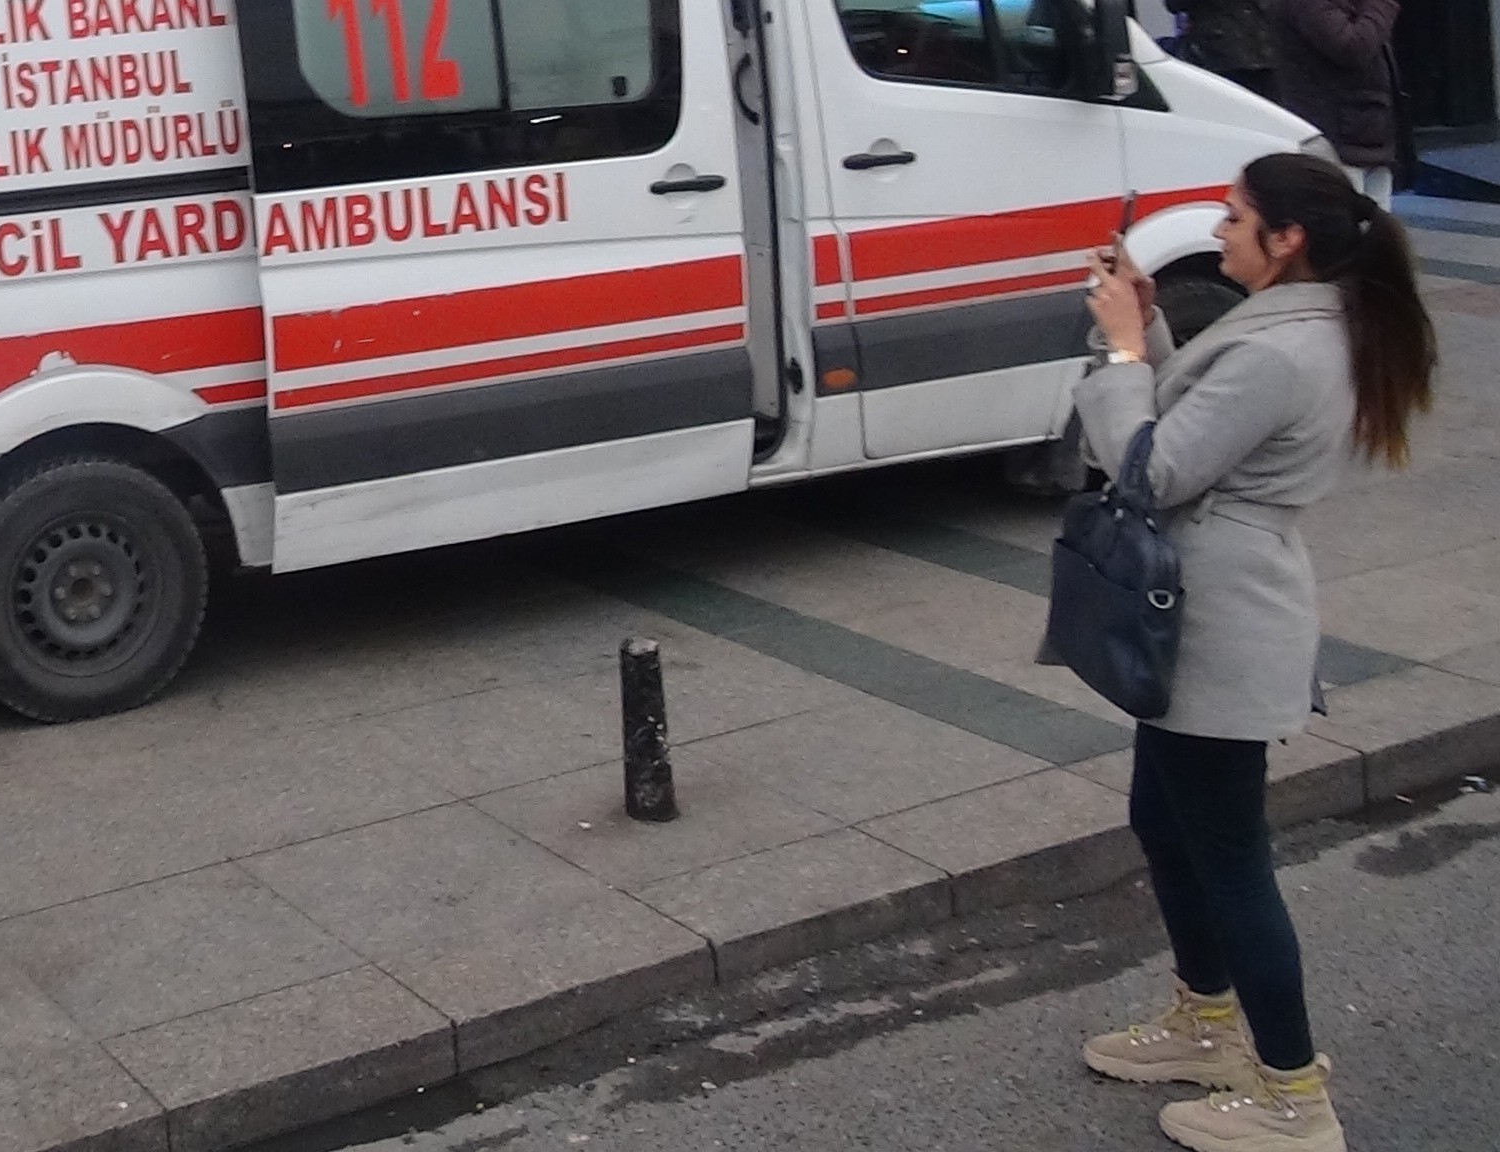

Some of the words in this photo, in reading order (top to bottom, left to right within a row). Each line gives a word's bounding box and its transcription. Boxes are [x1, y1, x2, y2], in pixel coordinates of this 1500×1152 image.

[1, 49, 192, 110] İSTANBUL
[62, 99, 242, 170] MÜDÜRLÜ
[98, 199, 245, 263] YARD
[261, 171, 569, 257] AMBULANSI
